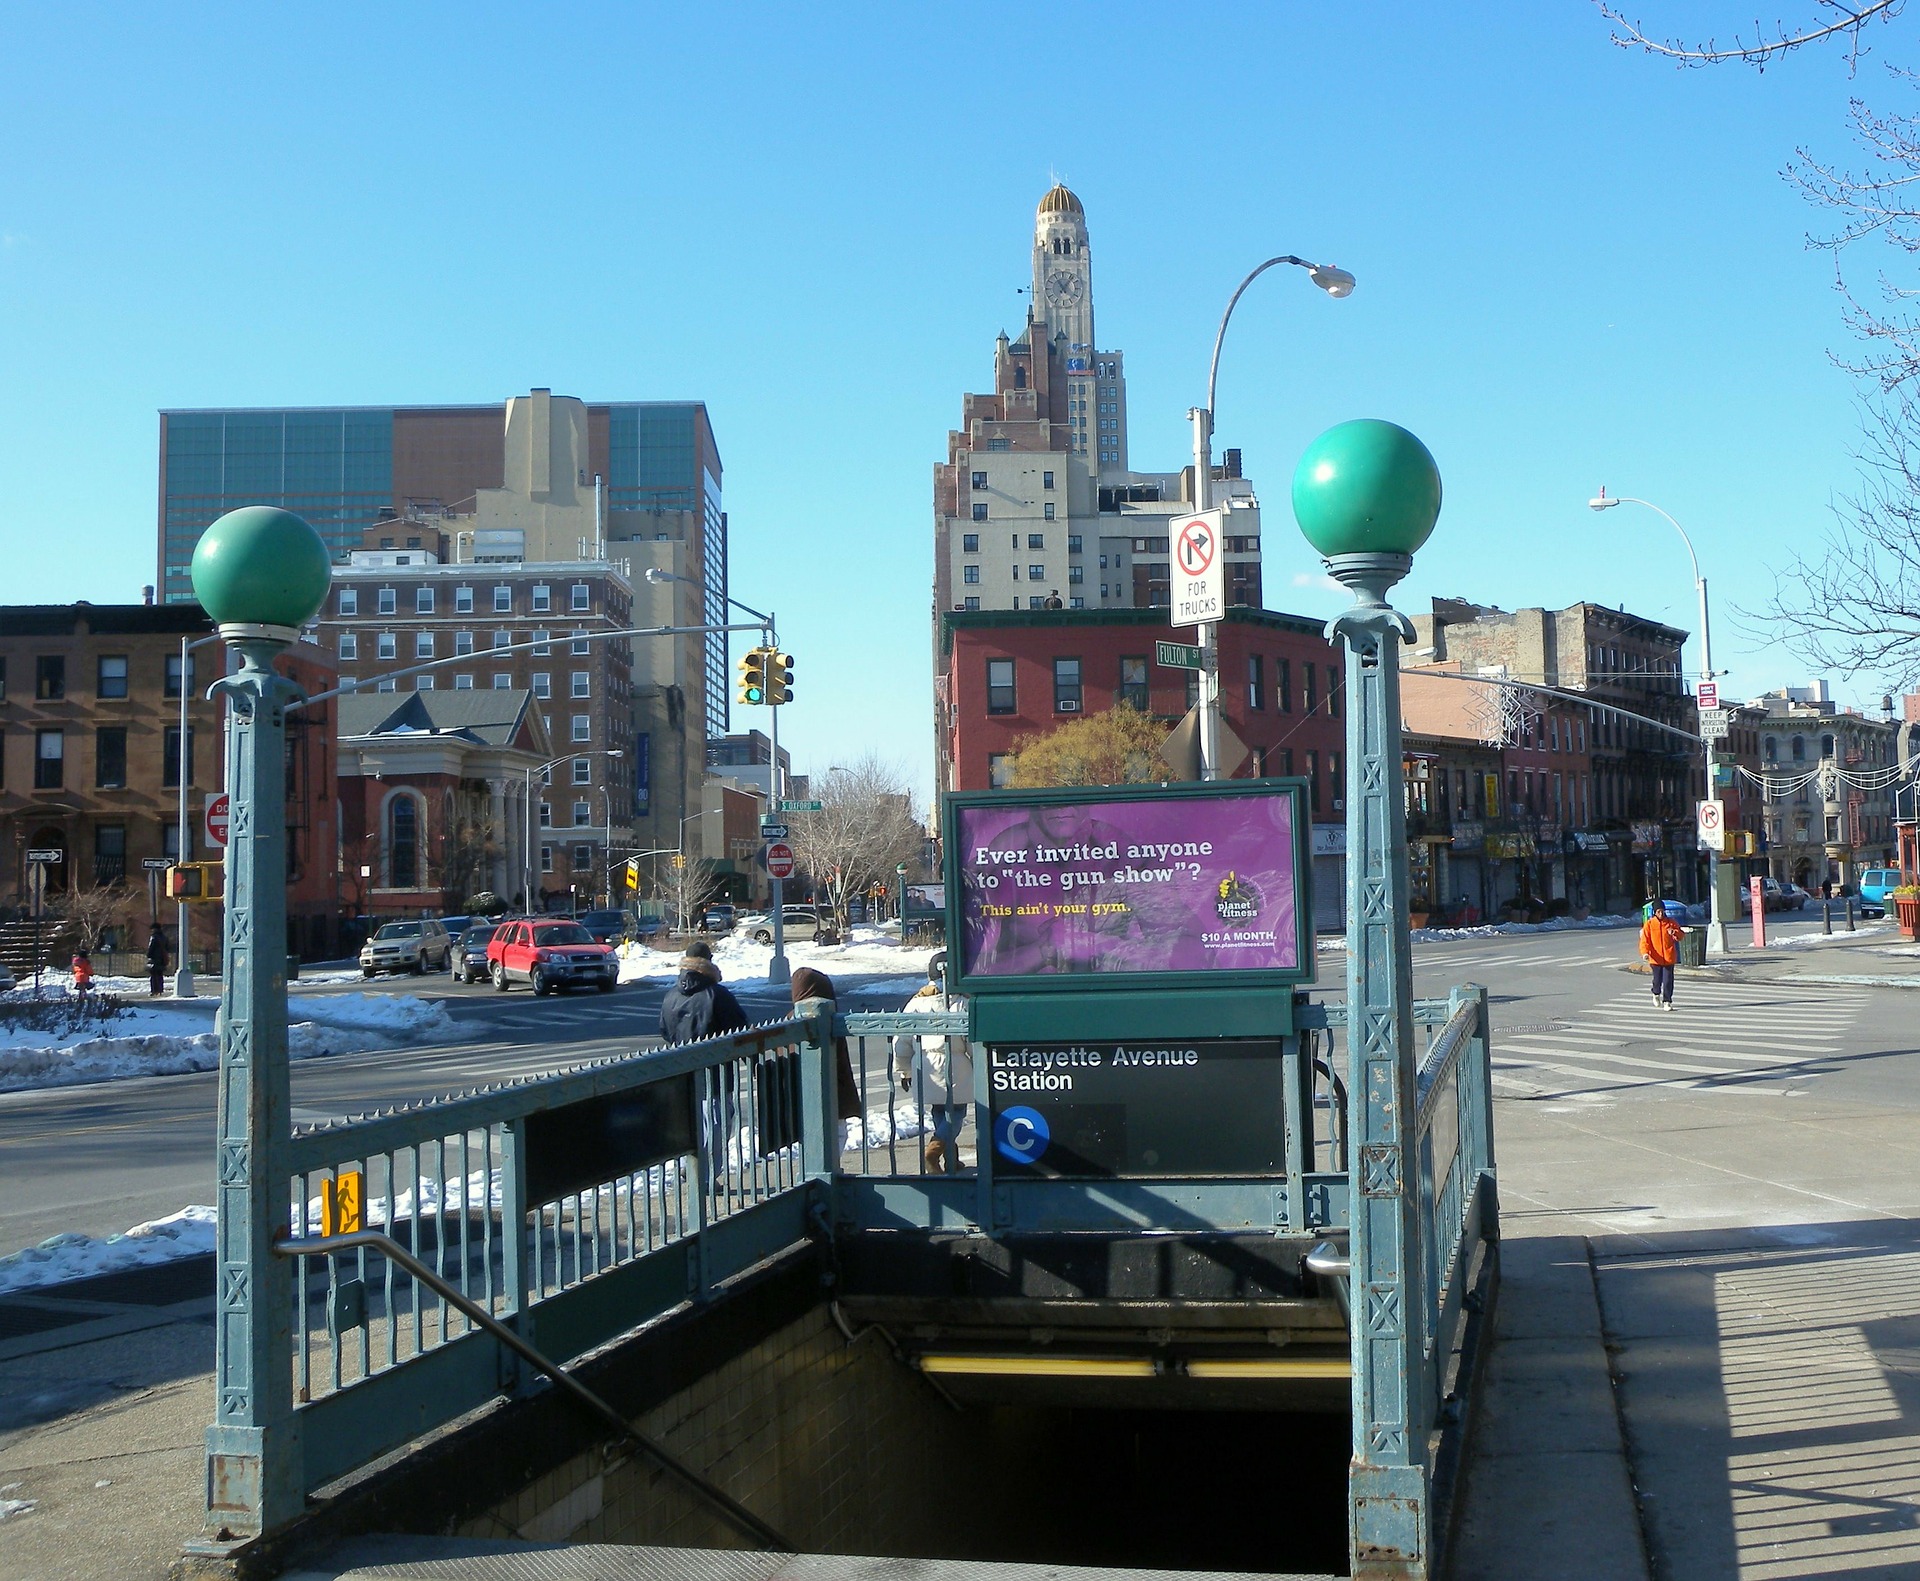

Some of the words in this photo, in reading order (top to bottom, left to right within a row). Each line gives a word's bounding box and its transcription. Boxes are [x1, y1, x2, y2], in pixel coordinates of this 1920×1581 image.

[1188, 580, 1206, 597] FOR
[1179, 597, 1217, 617] TRUCKS
[1160, 645, 1188, 665] FULTON
[1192, 649, 1199, 659] ST
[1704, 711, 1722, 719] KEEP
[1703, 727, 1725, 735] CLEAR
[781, 801, 787, 810] S
[788, 801, 812, 810] OXFORD
[975, 847, 1028, 865] Ever
[1036, 841, 1120, 864] invited
[1127, 841, 1213, 863] anyone
[976, 871, 999, 889] to
[1060, 868, 1106, 891] gun
[980, 904, 1012, 917] This
[1016, 901, 1049, 916] ain't
[1053, 903, 1088, 918] your
[1091, 902, 1132, 917] gym.
[1217, 901, 1251, 912] planet
[1222, 909, 1258, 918] fitness
[1201, 932, 1220, 943] $10
[1223, 933, 1231, 941] A
[1233, 931, 1278, 941] MONTH.
[991, 1047, 1102, 1071] Lafayette
[1111, 1046, 1199, 1067] Avenue
[993, 1070, 1073, 1091] Station
[1006, 1117, 1035, 1151] C
